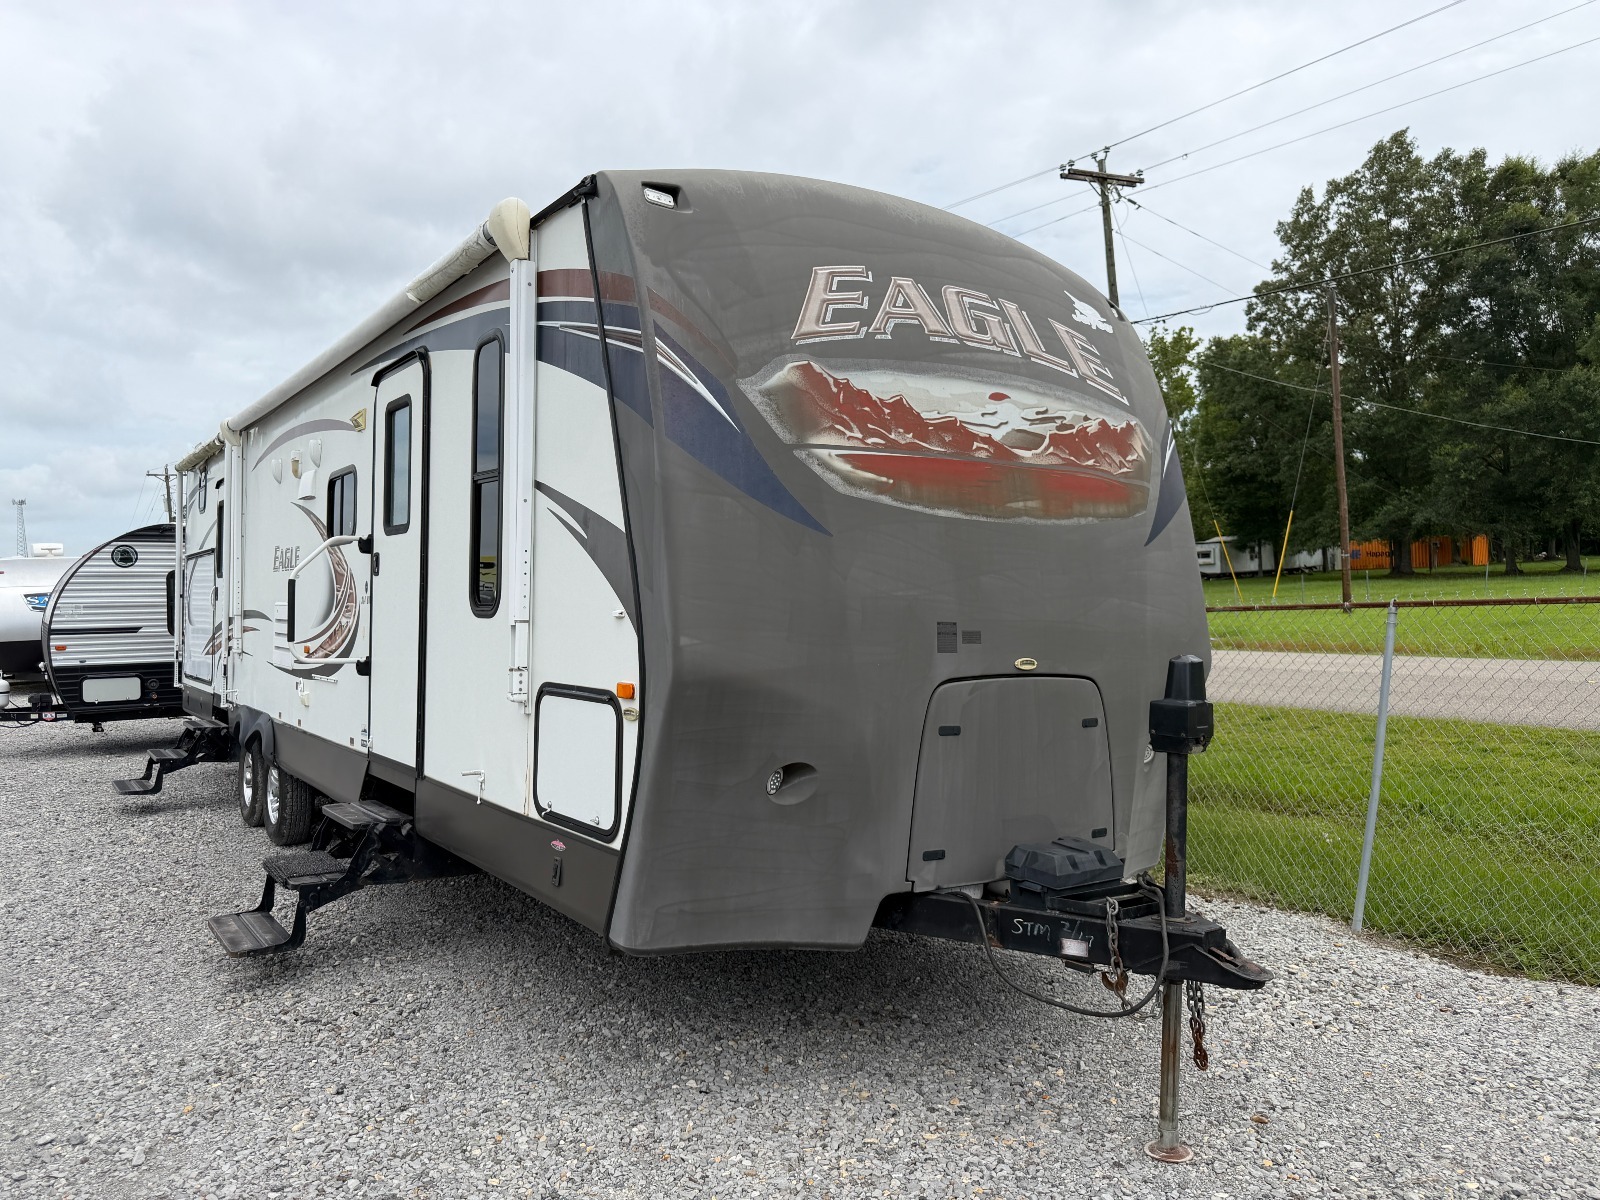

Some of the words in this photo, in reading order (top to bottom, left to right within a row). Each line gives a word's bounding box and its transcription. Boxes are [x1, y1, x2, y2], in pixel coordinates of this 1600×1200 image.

[791, 265, 1130, 406] EAGLE
[273, 545, 300, 572] EAGLE
[1011, 918, 1051, 942] STM
